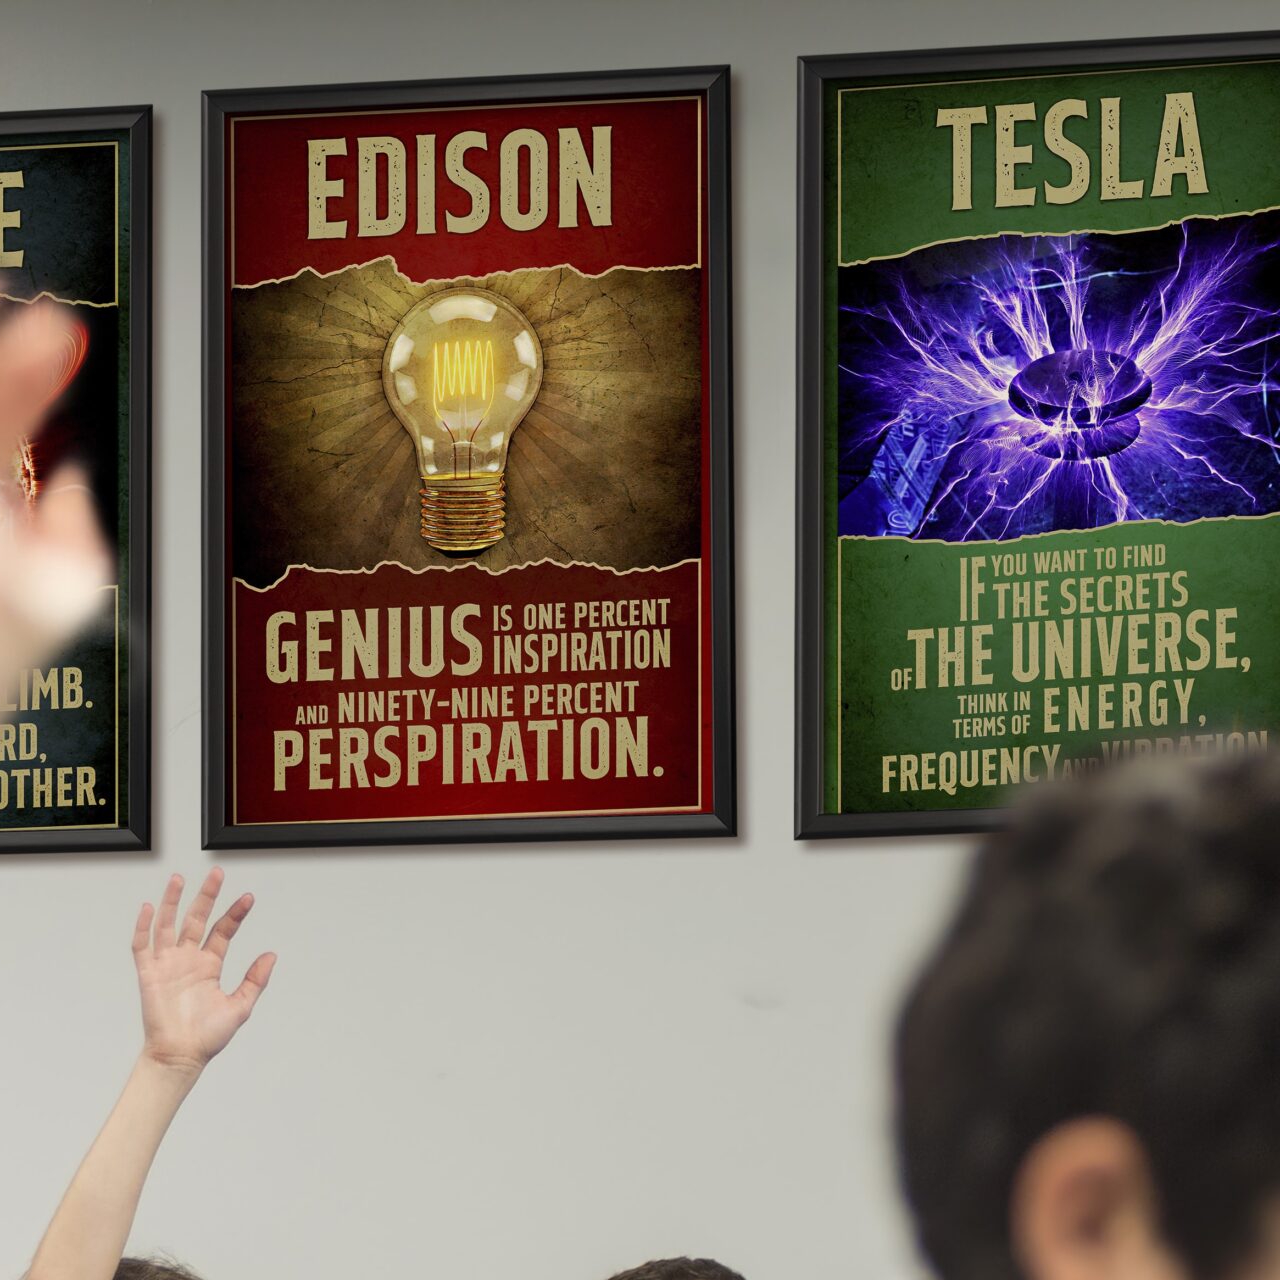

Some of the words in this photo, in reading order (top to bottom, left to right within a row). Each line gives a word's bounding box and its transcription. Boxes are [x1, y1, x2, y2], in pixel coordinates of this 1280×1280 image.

[936, 92, 1209, 210] TESLA
[308, 126, 612, 239] EDISON
[991, 553, 1027, 577] YOU
[1033, 549, 1087, 574] WANT
[1094, 547, 1117, 571] TO
[1123, 544, 1166, 568] FIND
[960, 556, 986, 621] IF
[992, 578, 1049, 619] THE
[1060, 571, 1188, 615] SECRETS
[493, 605, 513, 632] IS
[524, 602, 566, 630] ONE
[574, 598, 671, 628] PERCENT
[265, 603, 483, 684] GENIUS
[493, 629, 671, 674] INSPIRATION
[891, 668, 912, 691] OF
[907, 624, 994, 690] THE
[1012, 607, 1251, 683] UNIVERSE,
[0, 667, 93, 711] LIMB.
[295, 705, 328, 725] AND
[338, 687, 513, 724] NINETY-NINE
[524, 681, 640, 717] PERCENT
[957, 692, 1007, 714] THINK
[1013, 691, 1030, 710] IN
[1043, 678, 1206, 734] ENERGY,
[953, 717, 1006, 739] TERMS
[1012, 715, 1031, 735] OF
[273, 716, 664, 791] PERSPIRATION.
[882, 744, 1061, 795] FREQUENCY
